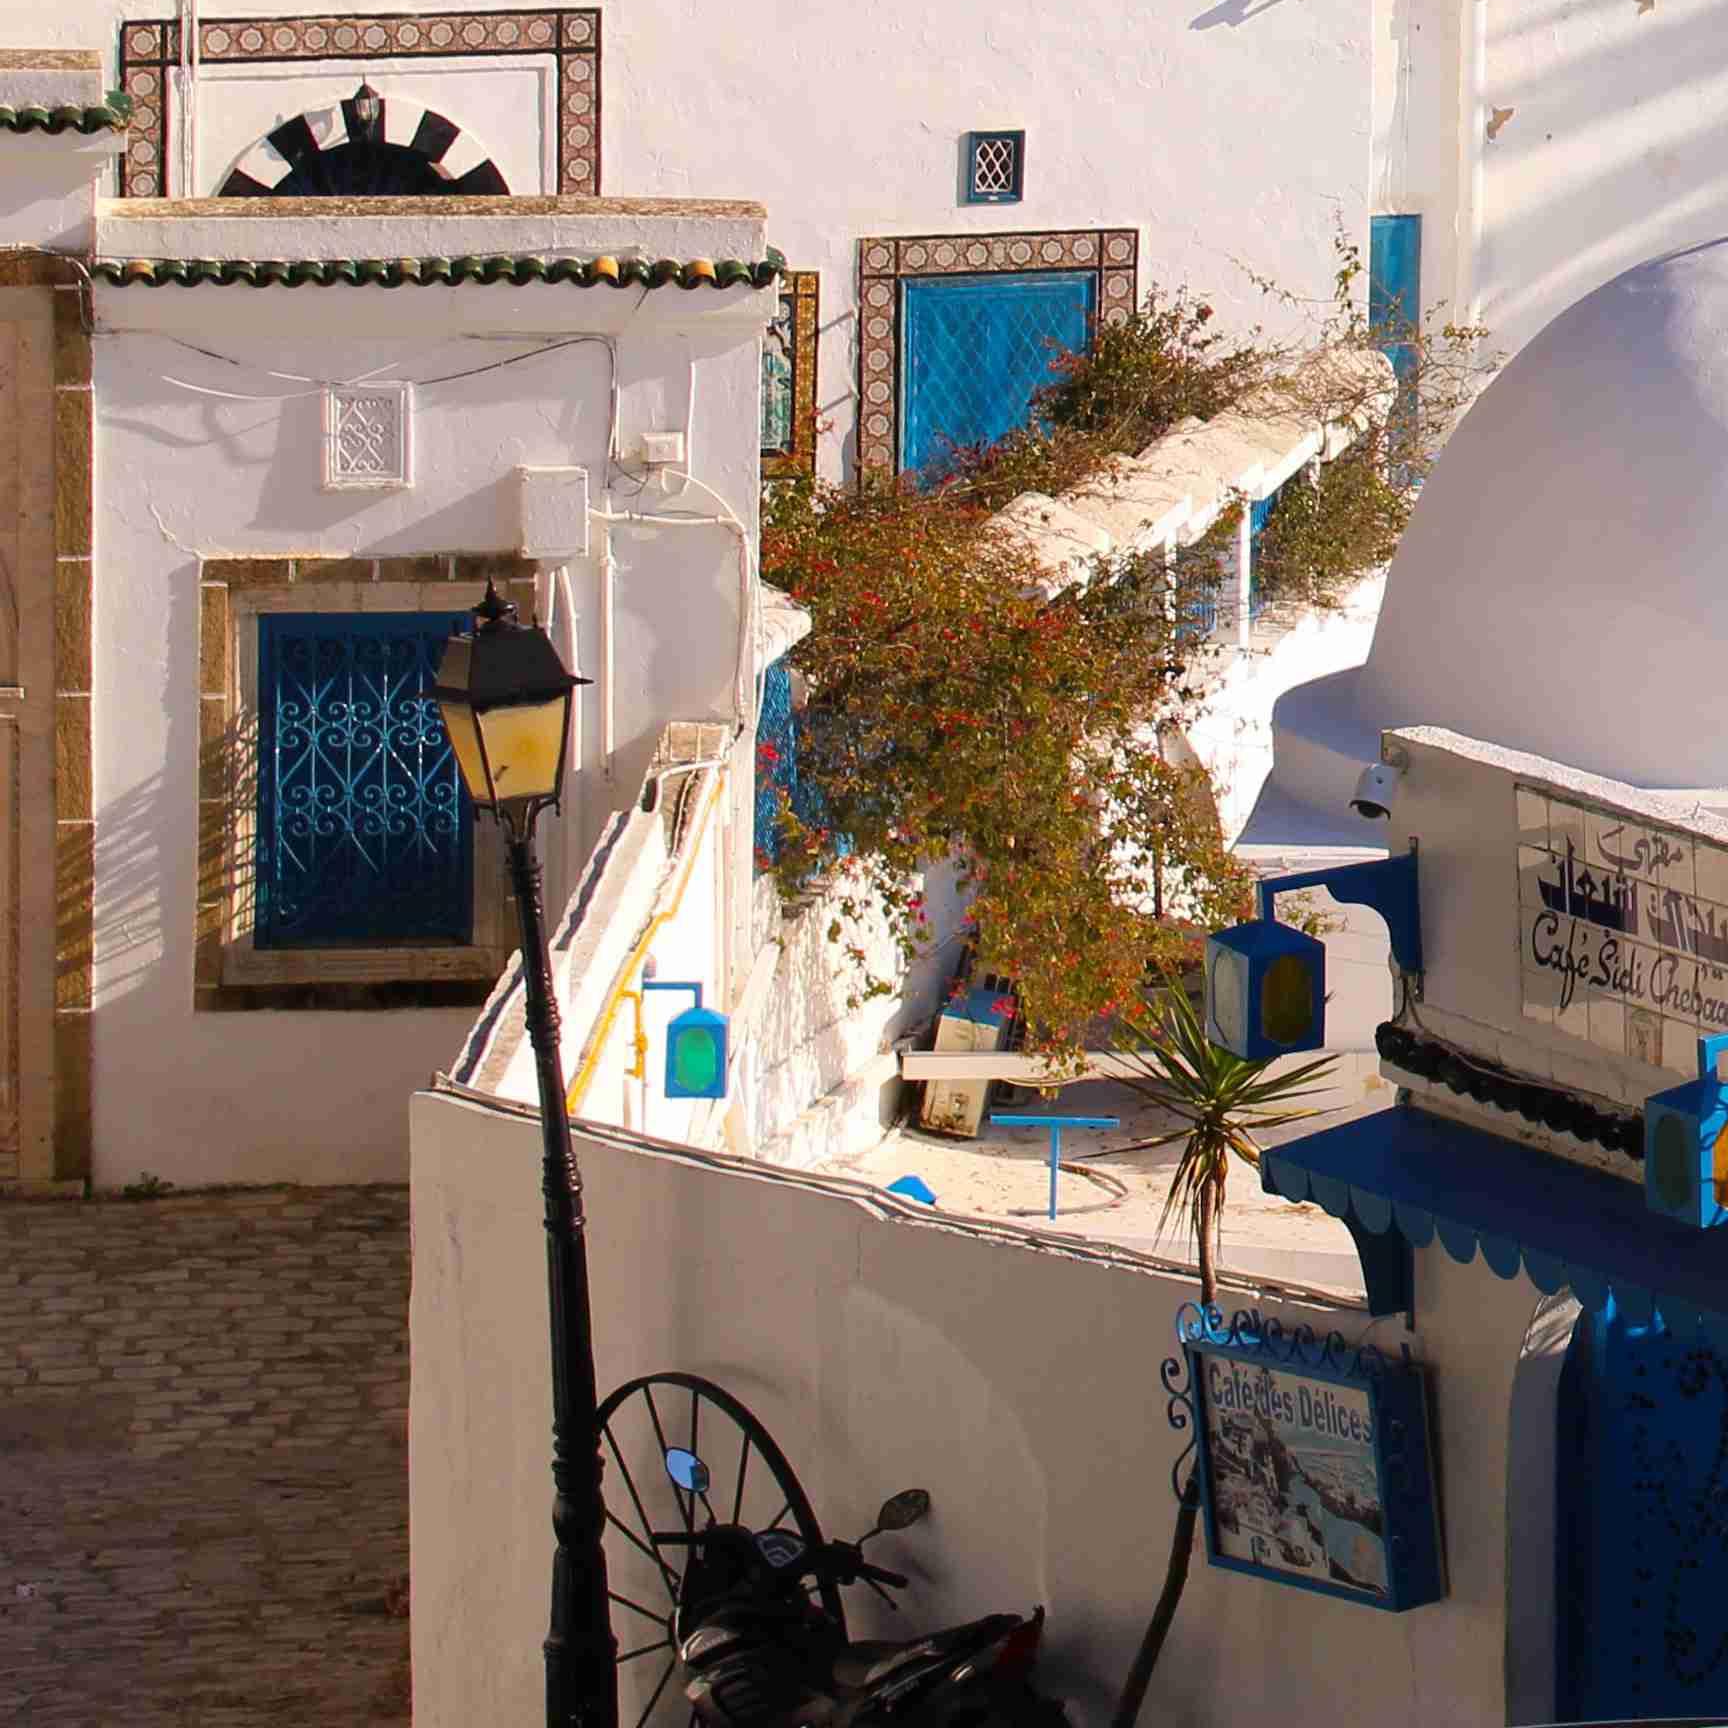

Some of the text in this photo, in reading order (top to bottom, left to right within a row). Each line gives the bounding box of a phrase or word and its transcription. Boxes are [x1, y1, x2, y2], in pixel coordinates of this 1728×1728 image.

[1532, 910, 1590, 1012] Café
[1590, 937, 1645, 999] Sidi
[1208, 1361, 1374, 1443] Café des Délices
